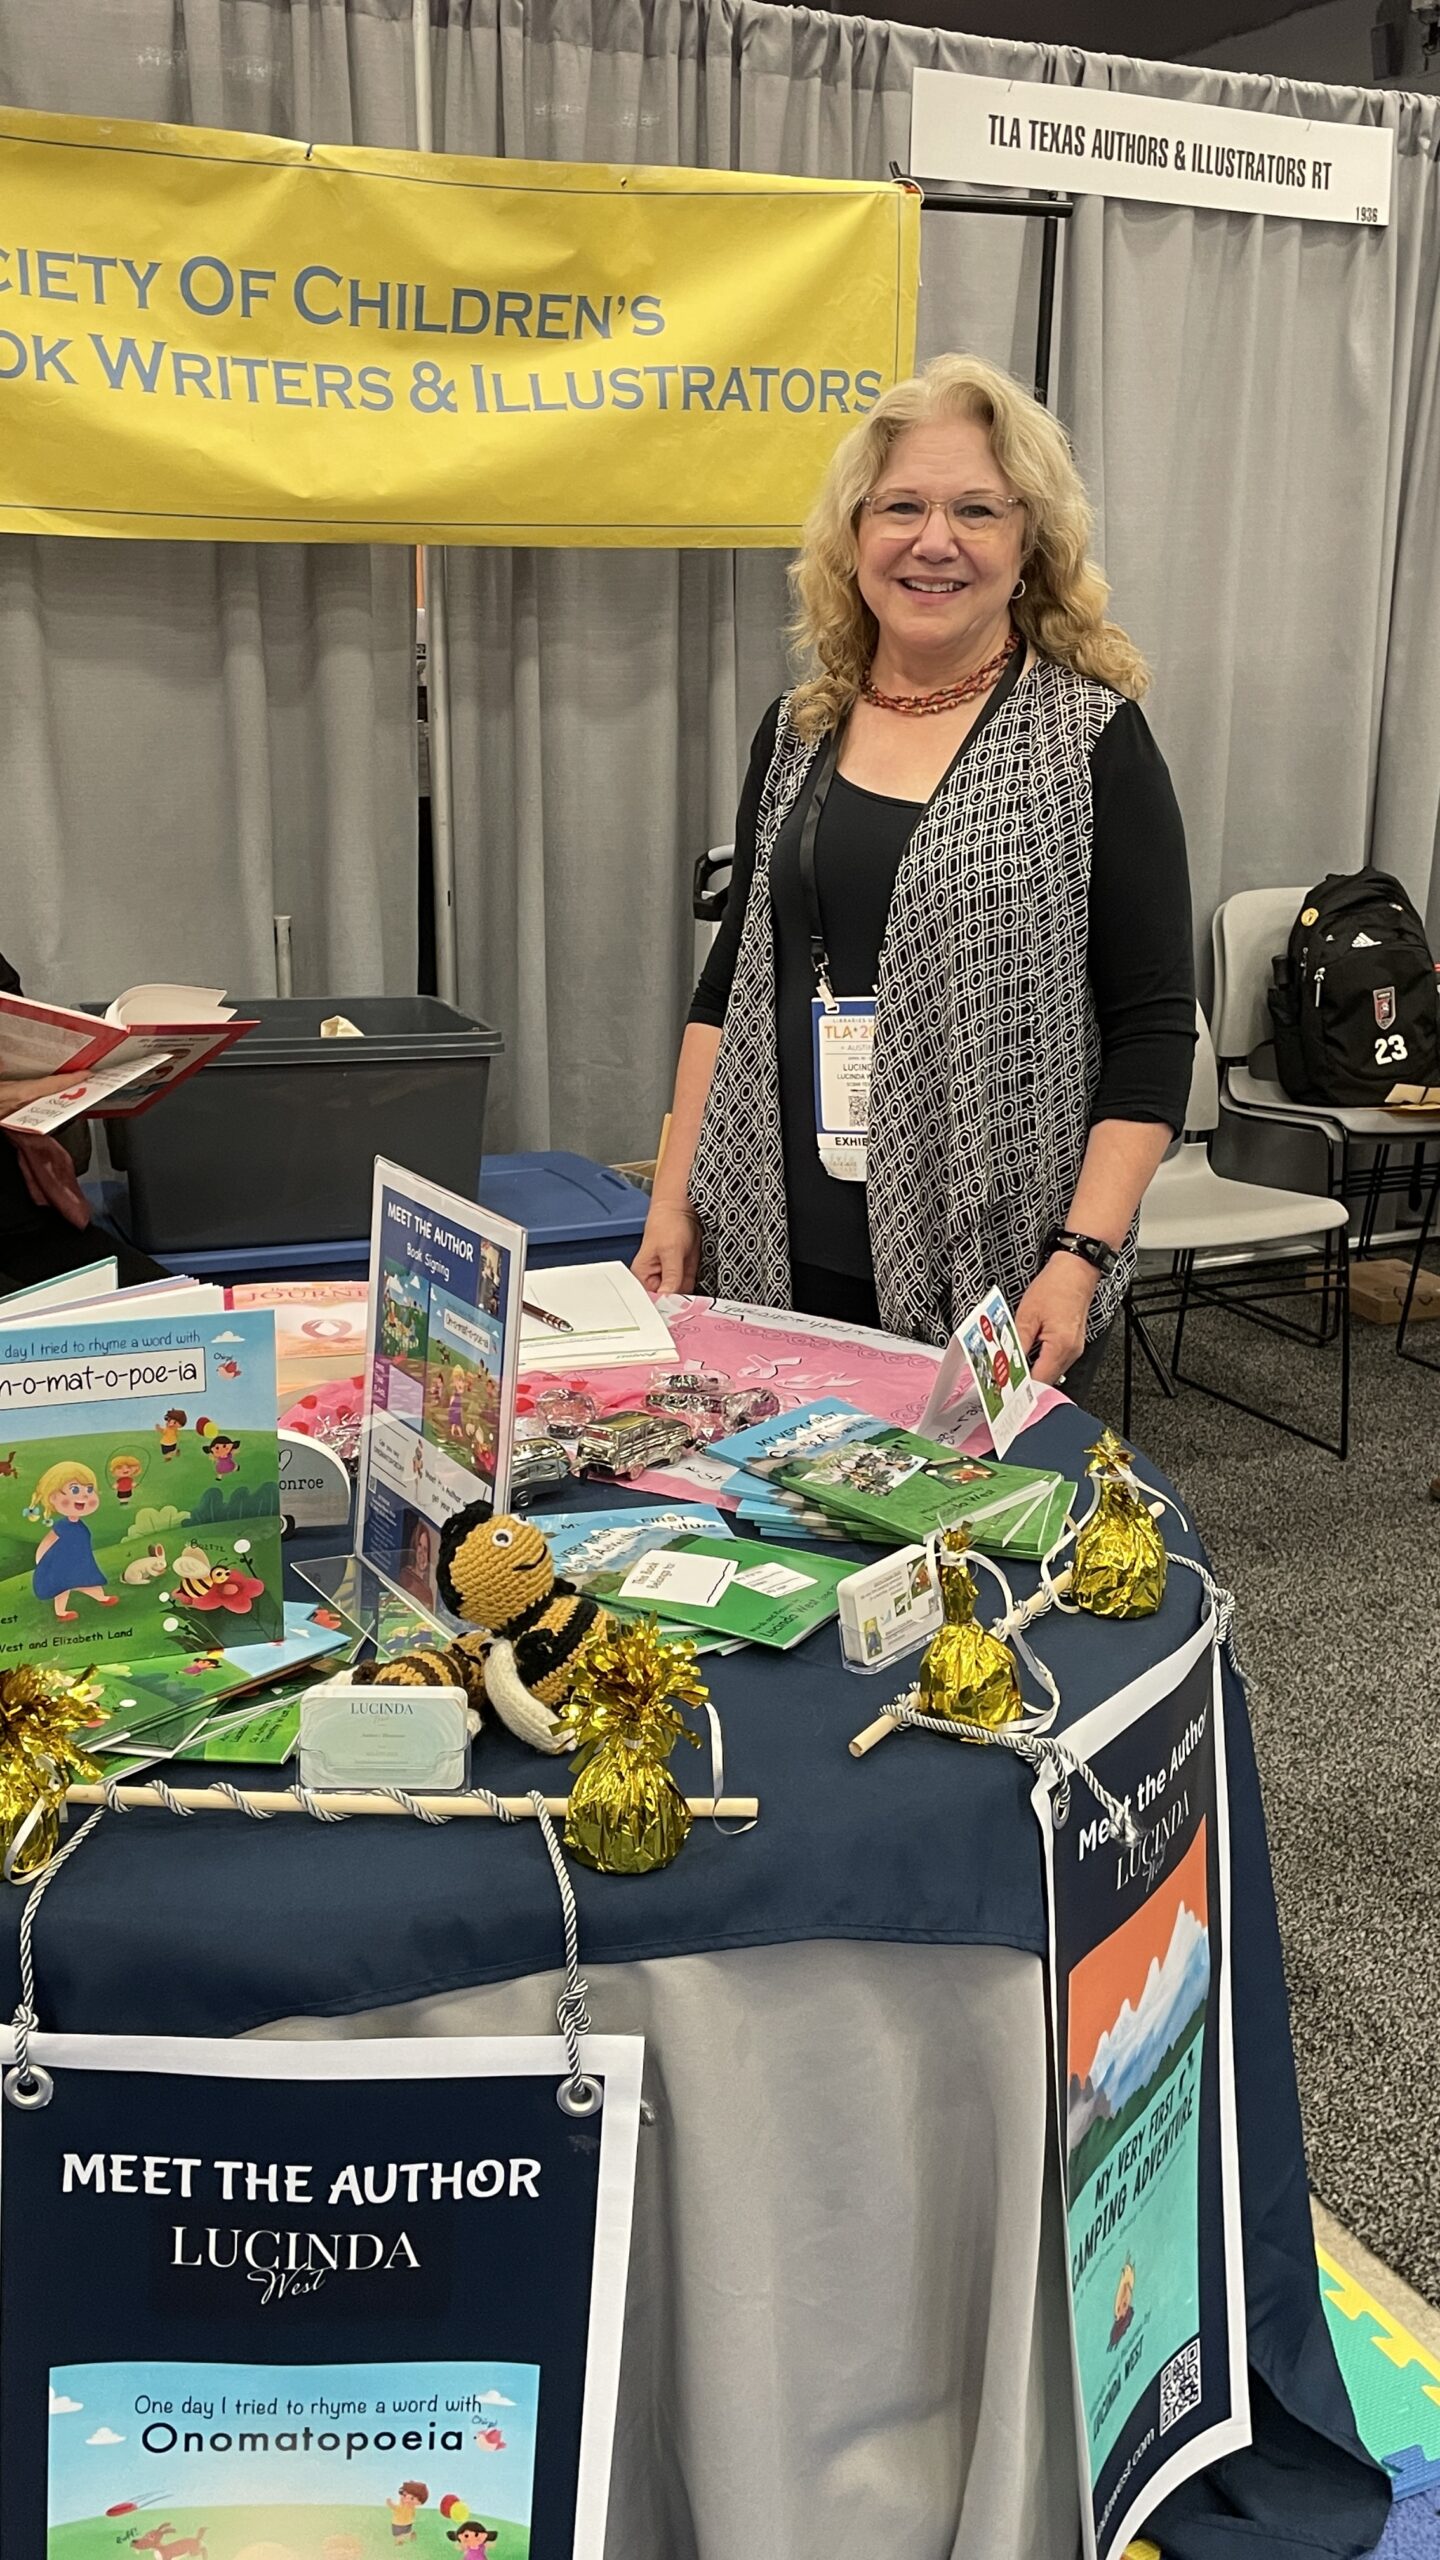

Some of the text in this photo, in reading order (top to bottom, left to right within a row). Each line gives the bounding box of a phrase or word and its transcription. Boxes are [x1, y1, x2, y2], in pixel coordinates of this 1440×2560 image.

[988, 113, 1332, 191] TLA TEXAS AUTHORS & ILLUSTRATORS RT
[1355, 206, 1378, 224] 1936
[179, 254, 277, 319] OF
[293, 264, 666, 342] CHILDREN'S
[87, 332, 395, 412] WRITERS
[409, 360, 459, 415] &
[472, 363, 883, 416] ILLUSTRATORS
[1375, 1034, 1408, 1065] 23
[387, 1202, 474, 1263] MEET THE AUTHOR
[406, 1242, 450, 1282] Book Signing
[5, 1344, 28, 1361] day
[41, 1341, 68, 1354] tried
[73, 1339, 85, 1353] to
[88, 1336, 128, 1356] rhyme
[131, 1338, 139, 1348] a
[142, 1332, 172, 1346] word
[176, 1329, 200, 1344] with
[28, 1638, 48, 1649] and
[52, 1629, 104, 1647] Elizabeth
[108, 1627, 133, 1641] Land
[351, 1702, 414, 1715] LUCINDA
[1078, 1795, 1132, 1861] Met
[1137, 1769, 1167, 1813] the
[1116, 1790, 1190, 1890] LUCINDA
[1093, 2083, 1176, 2209] MY VERY FIRST
[1132, 2083, 1195, 2203] ADVENTURE
[62, 2153, 542, 2205] MEET THE AUTHOR
[171, 2226, 422, 2272] LUCINDA
[247, 2263, 328, 2305] West
[134, 2394, 482, 2419] One day I tried to rhyme a word with
[142, 2423, 463, 2459] Onomatopoeia
